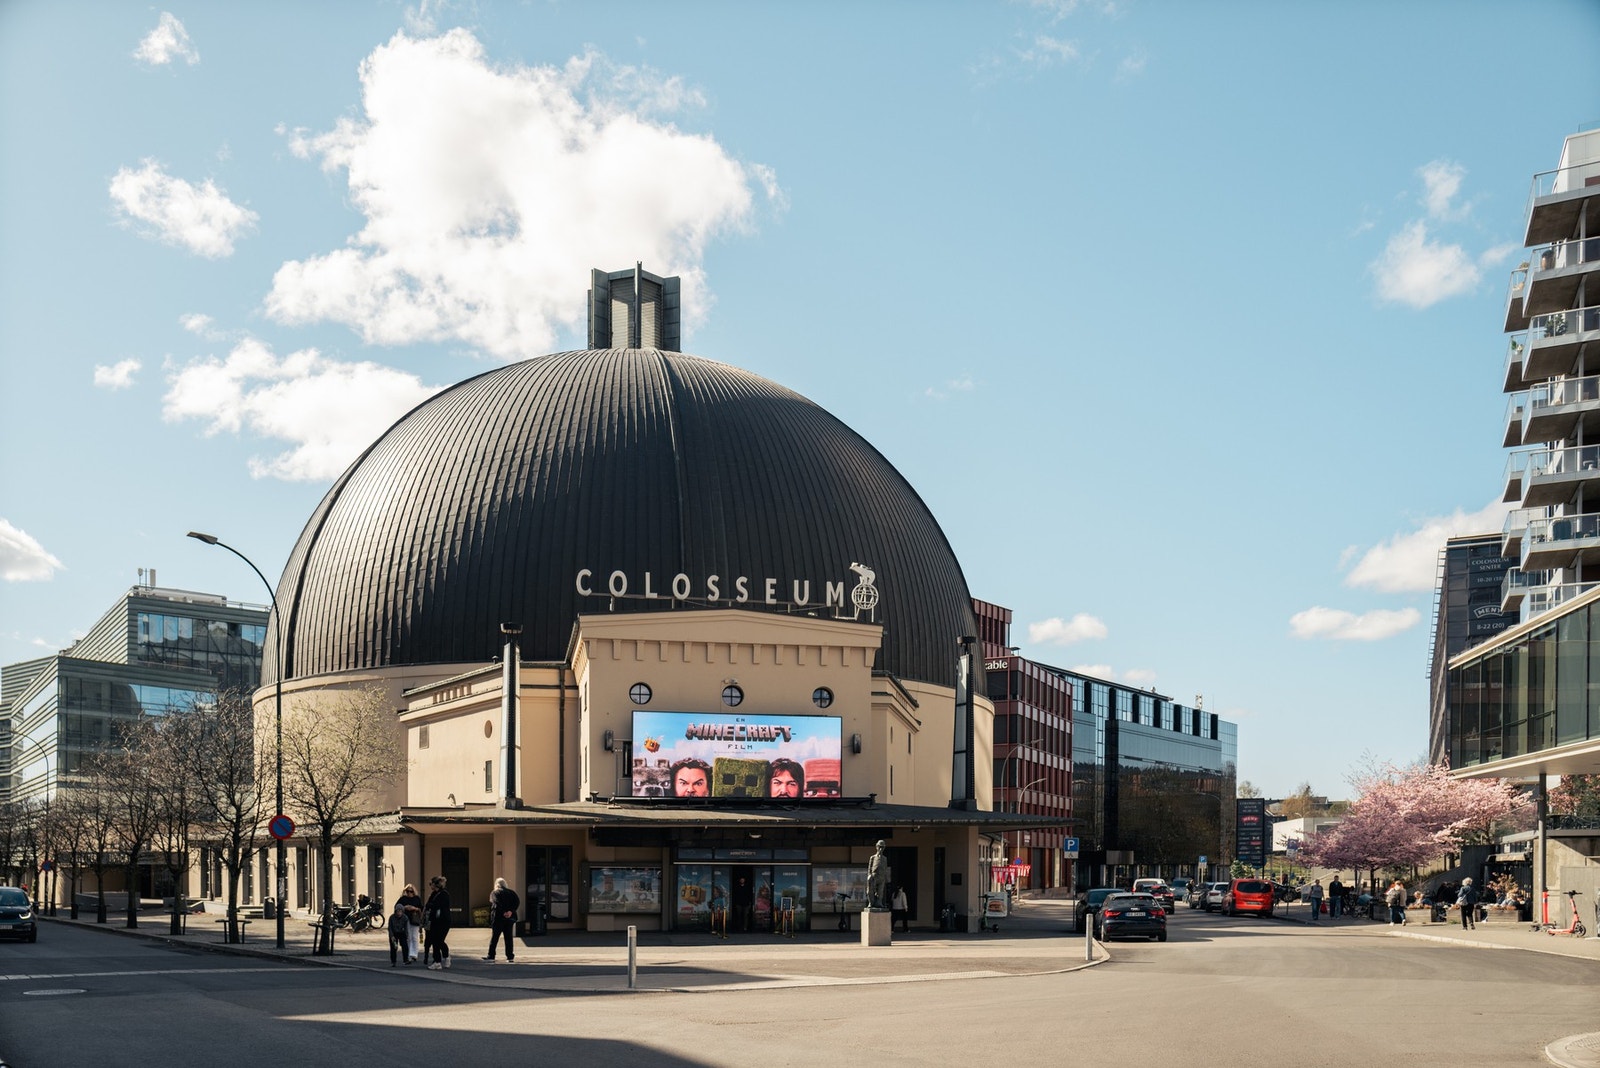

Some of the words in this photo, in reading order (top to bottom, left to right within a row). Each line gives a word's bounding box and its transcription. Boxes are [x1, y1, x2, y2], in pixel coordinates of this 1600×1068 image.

[575, 568, 845, 608] COLOSSEUM
[685, 722, 792, 743] MINECRAFT
[1067, 840, 1075, 850] P
